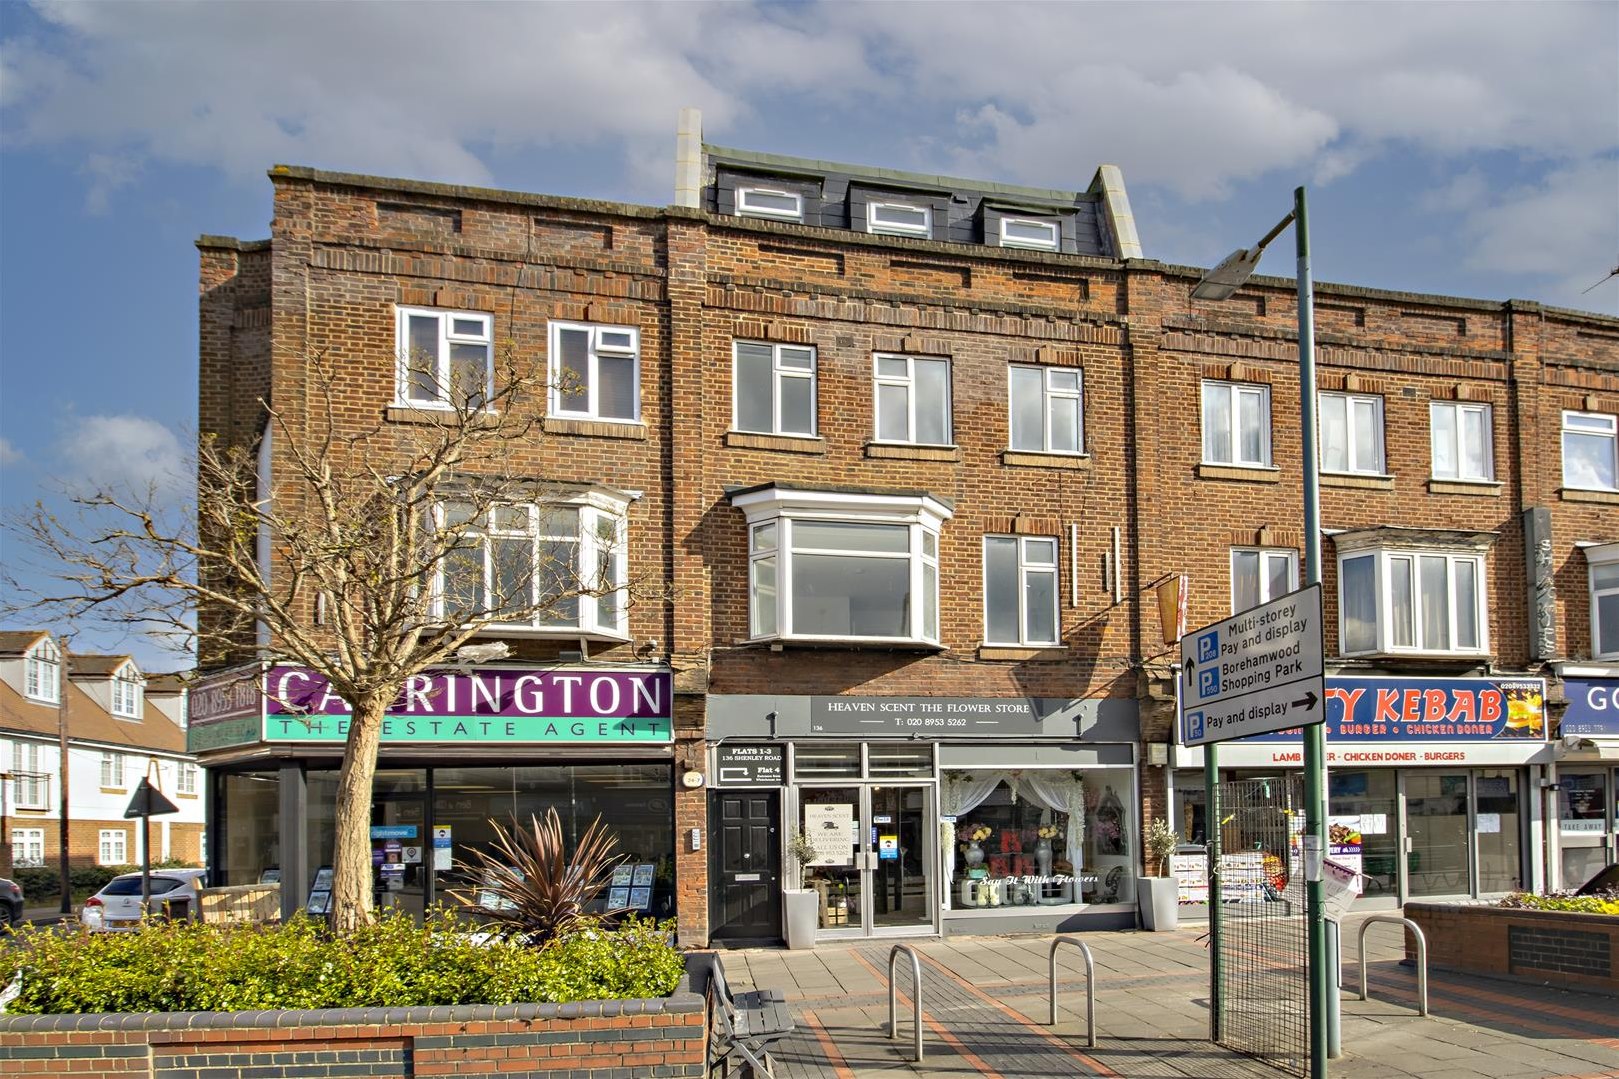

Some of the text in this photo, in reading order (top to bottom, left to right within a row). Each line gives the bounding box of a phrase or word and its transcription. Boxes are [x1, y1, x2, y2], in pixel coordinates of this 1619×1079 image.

[1228, 604, 1296, 637] Multi-storey
[1221, 618, 1307, 656] Pay and display
[1222, 640, 1300, 676] Borehamwood
[1221, 660, 1303, 692] Shopping Park
[278, 671, 660, 714] CARINGTON
[1374, 688, 1502, 722] KEBAB
[828, 702, 1029, 713] HEAVEN SCENT THE FLOWER STORE
[894, 717, 966, 726] T: 020 8953 5262
[1206, 701, 1288, 729] Pay and display
[279, 720, 661, 736] THE ESTATE AGENT
[1340, 724, 1493, 735] BURGER CHICKEN DONER
[1272, 752, 1302, 762] LAMB
[1343, 752, 1383, 762] CHICKEN
[1385, 752, 1416, 762] DONER
[1424, 752, 1465, 761] BURGERS
[979, 876, 1001, 887] Say
[1021, 874, 1050, 885] With
[1052, 873, 1099, 885] Flowers
